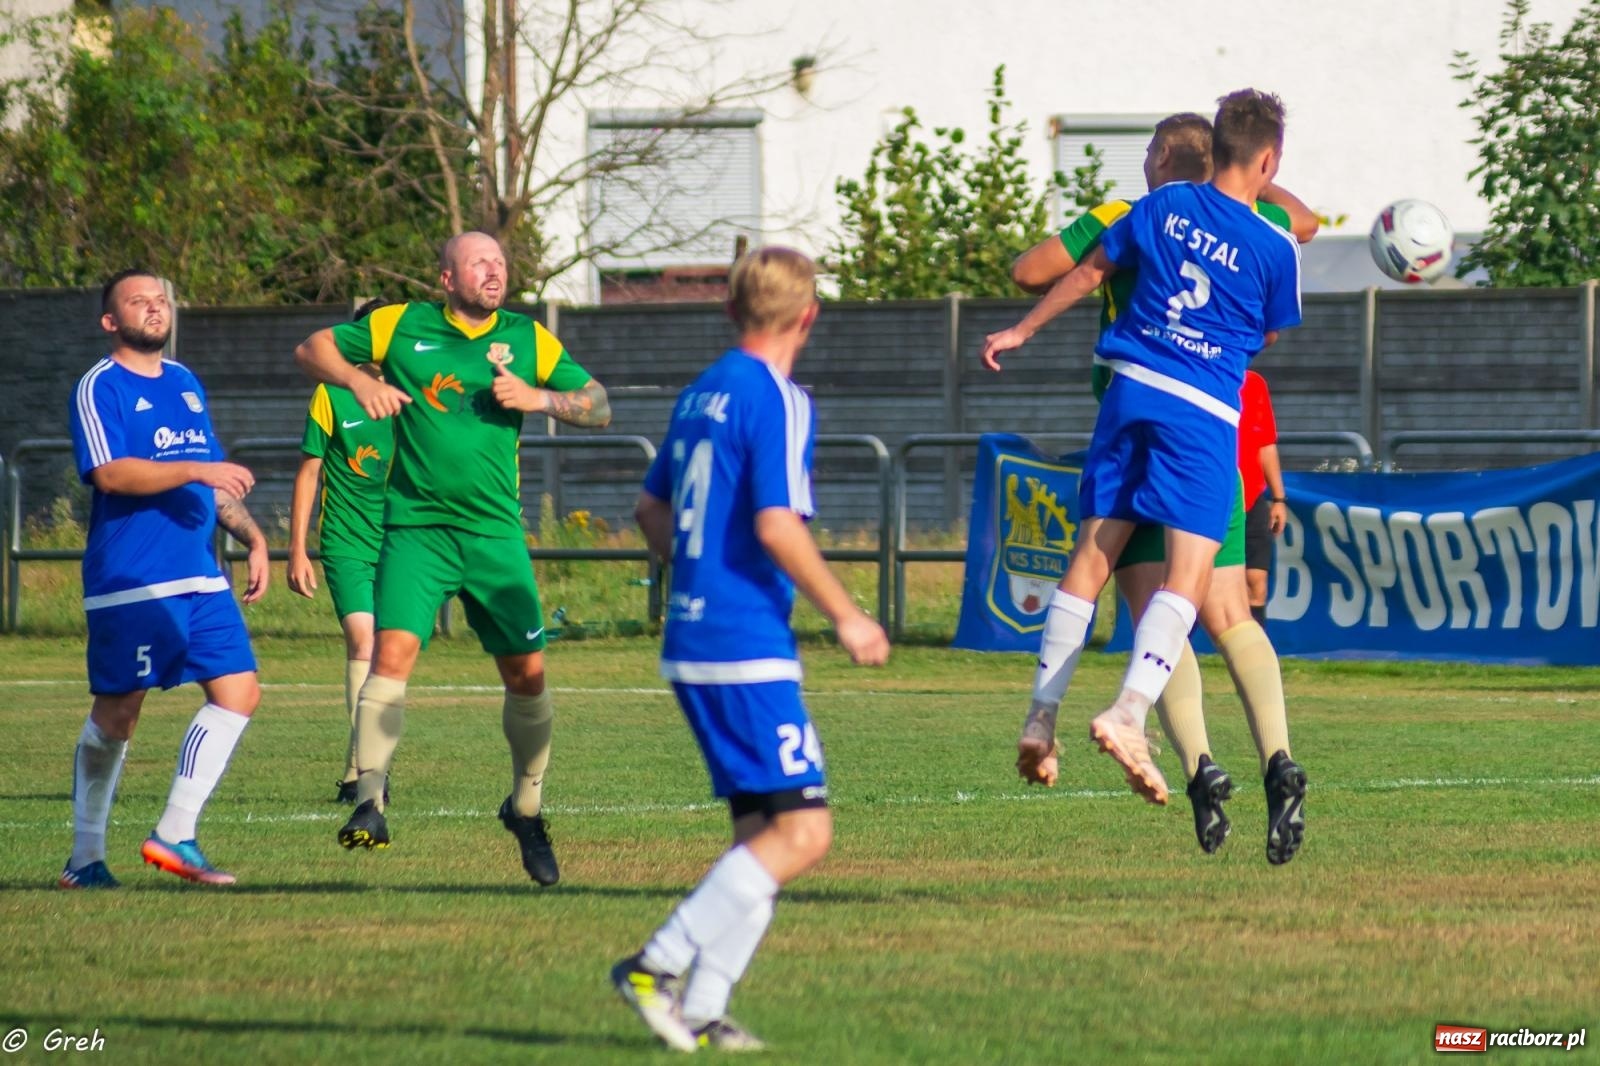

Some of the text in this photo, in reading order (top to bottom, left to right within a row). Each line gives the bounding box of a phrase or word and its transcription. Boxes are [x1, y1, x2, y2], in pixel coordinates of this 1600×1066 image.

[1164, 212, 1240, 272] KS STAL
[1166, 259, 1211, 339] 2
[1031, 554, 1065, 574] STAL
[136, 645, 152, 678] 5
[776, 721, 823, 777] 24
